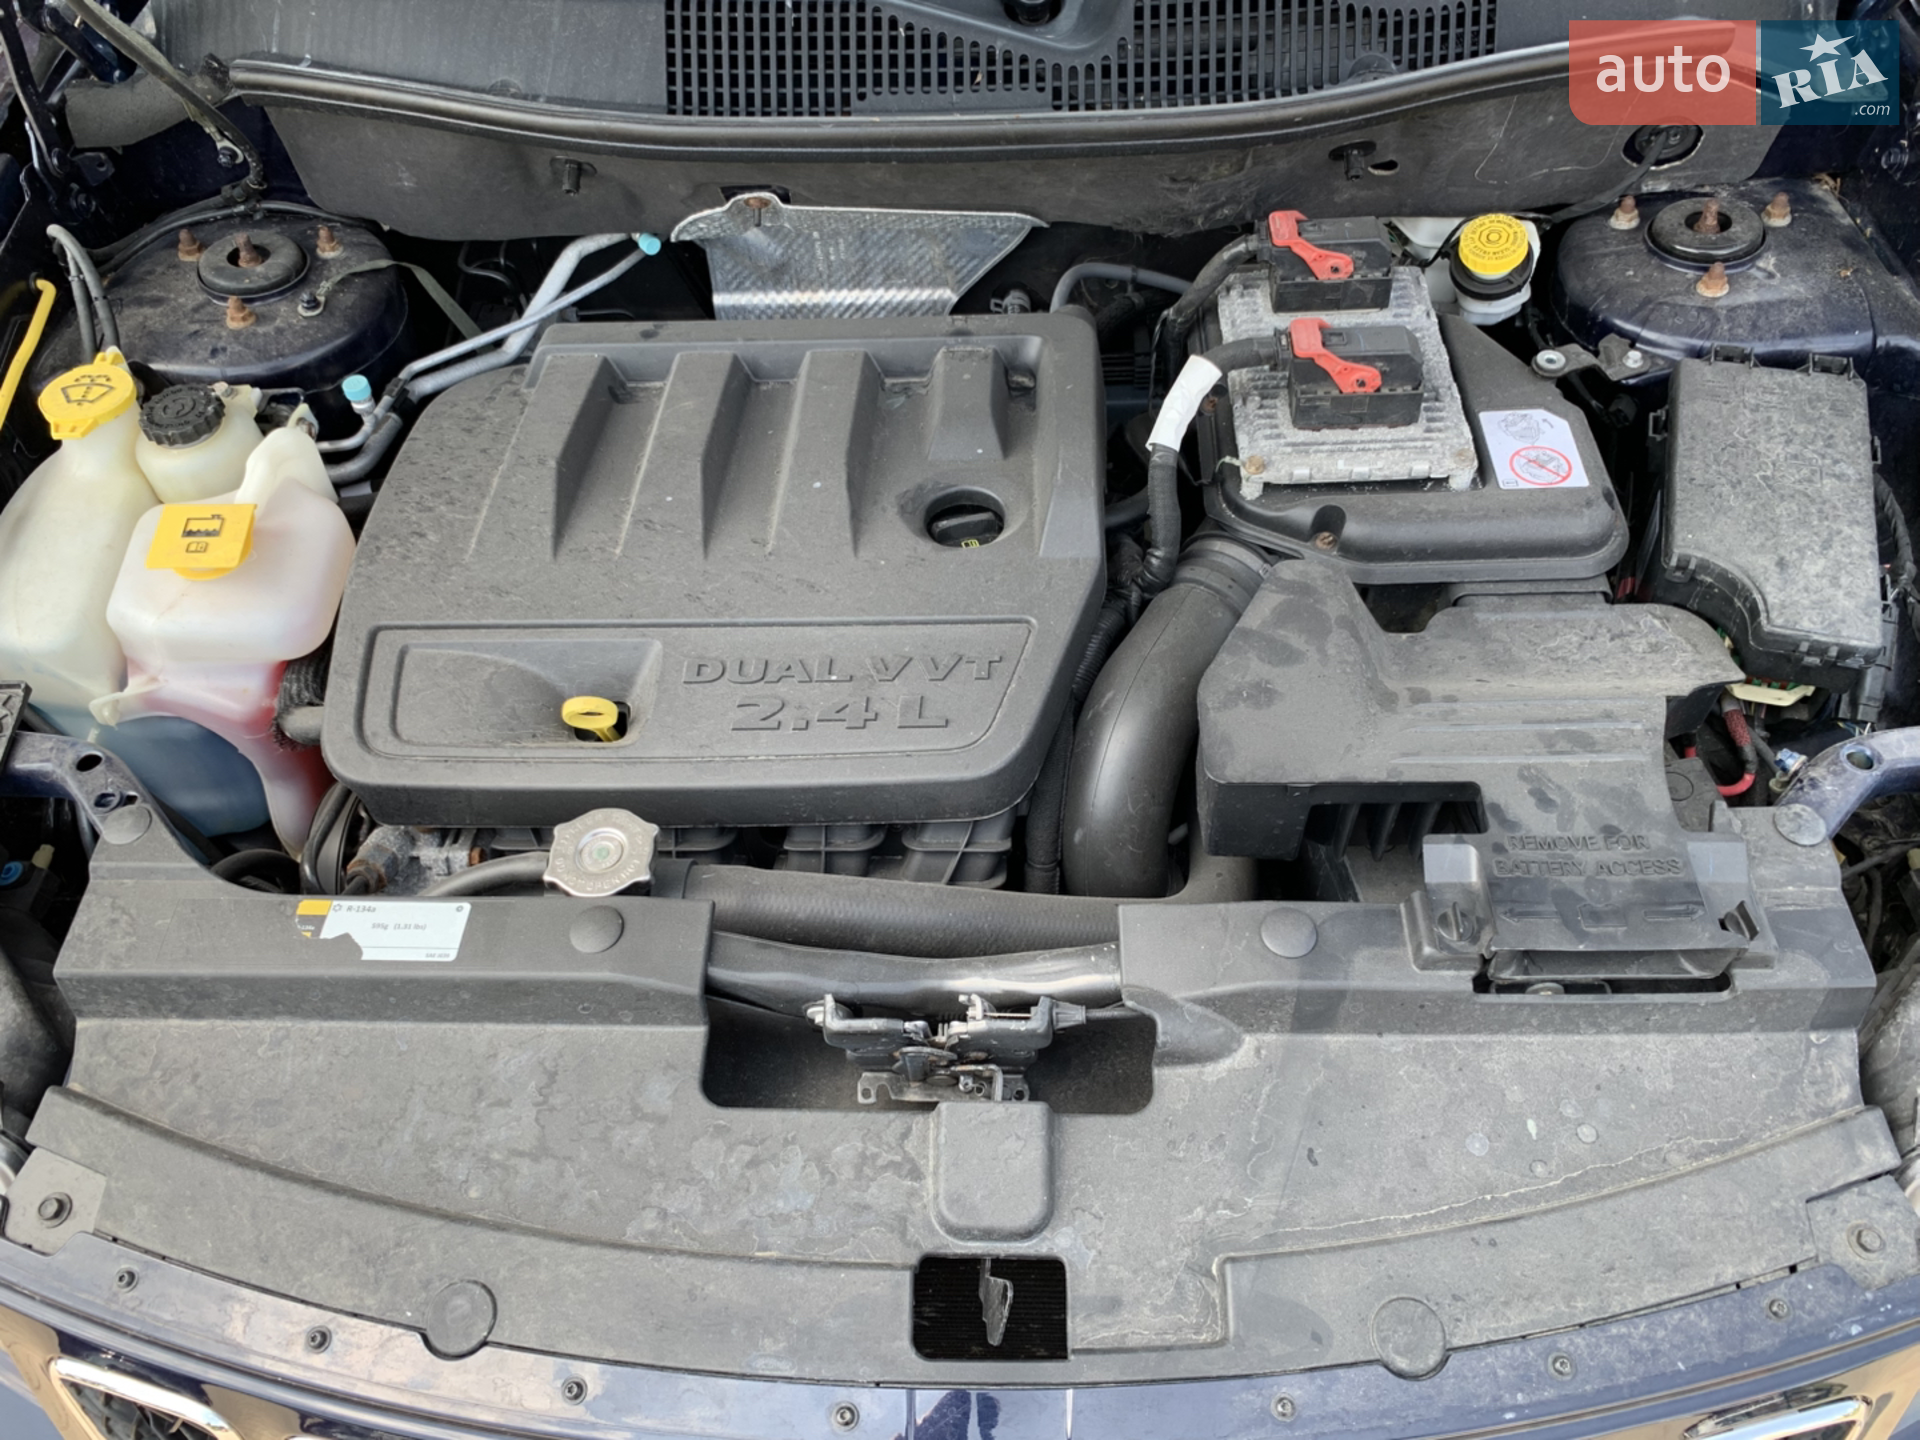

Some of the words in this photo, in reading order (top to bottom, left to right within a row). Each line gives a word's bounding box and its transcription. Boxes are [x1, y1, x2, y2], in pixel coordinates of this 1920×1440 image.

[683, 656, 853, 684] DUAL
[1506, 835, 1598, 851] REMOVE
[1603, 834, 1650, 851] FOR
[1494, 859, 1586, 877] BATTERY
[1599, 858, 1684, 876] ACCESS
[346, 905, 377, 913] R-134a
